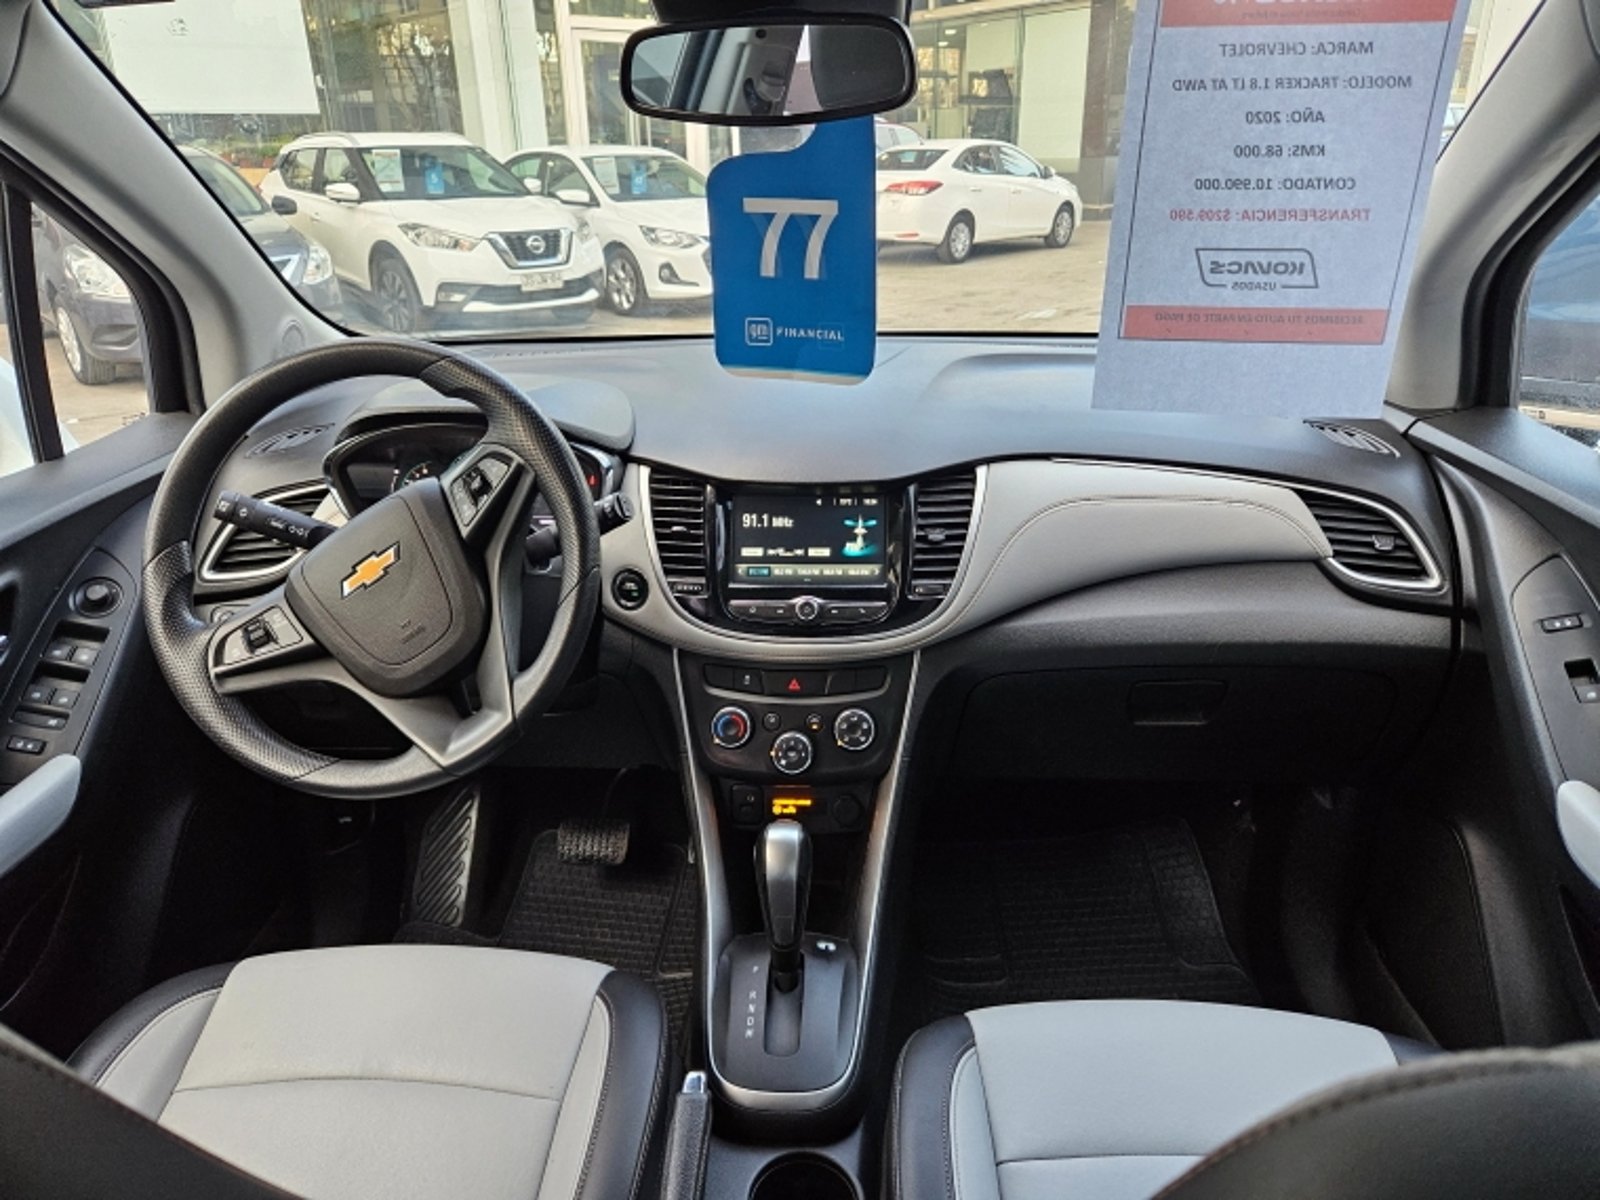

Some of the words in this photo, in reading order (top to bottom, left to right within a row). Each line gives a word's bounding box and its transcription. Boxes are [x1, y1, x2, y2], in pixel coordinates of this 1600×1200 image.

[743, 197, 839, 279] 77
[776, 326, 845, 342] FINANCIAL
[742, 513, 769, 528] 91.1
[772, 516, 794, 528] MHz
[746, 1016, 755, 1027] D
